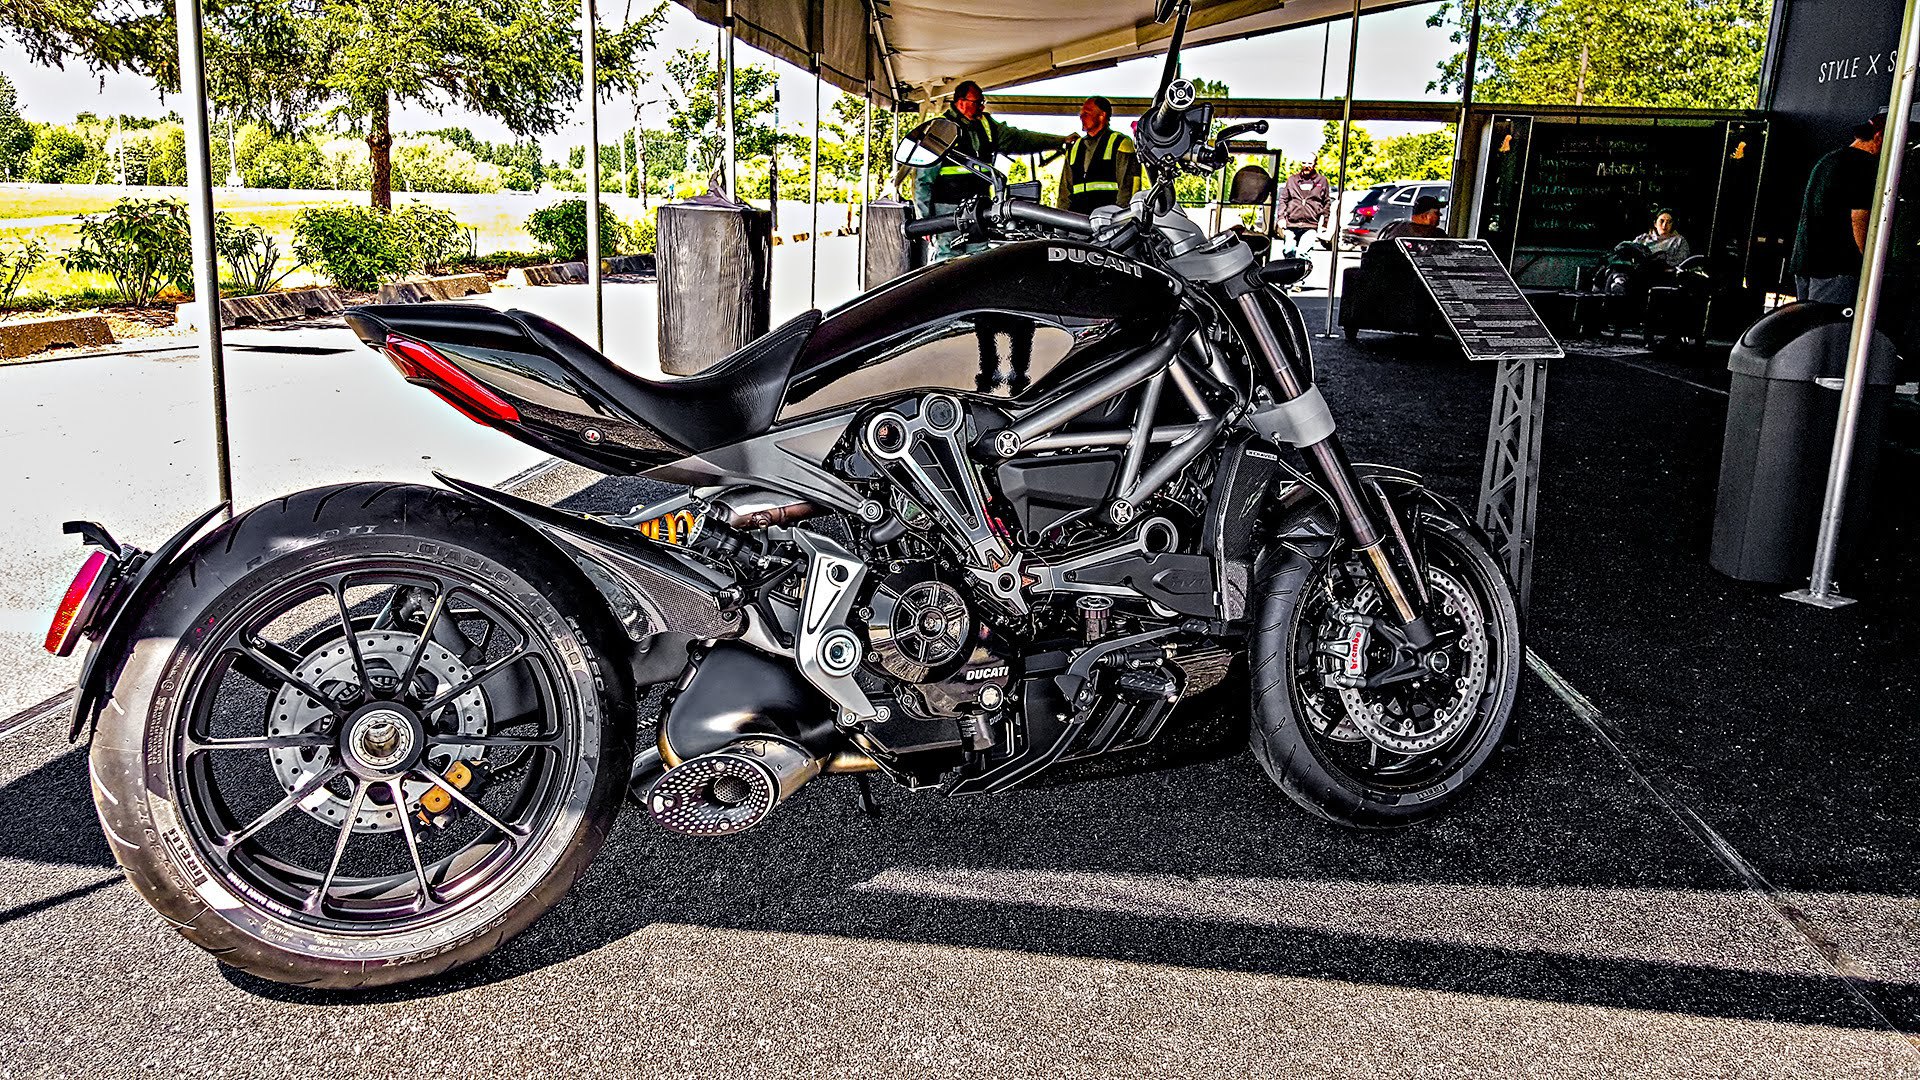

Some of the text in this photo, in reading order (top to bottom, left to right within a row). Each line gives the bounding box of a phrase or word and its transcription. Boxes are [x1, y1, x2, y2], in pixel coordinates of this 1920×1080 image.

[1818, 57, 1860, 84] STYLE
[1865, 53, 1881, 76] X
[1048, 247, 1142, 278] DUCATI
[417, 541, 511, 584] DIABLO
[564, 616, 605, 692] ROSSO
[1350, 632, 1362, 669] brembo
[966, 666, 1009, 680] DUCATI
[162, 827, 208, 888] PIRELLI
